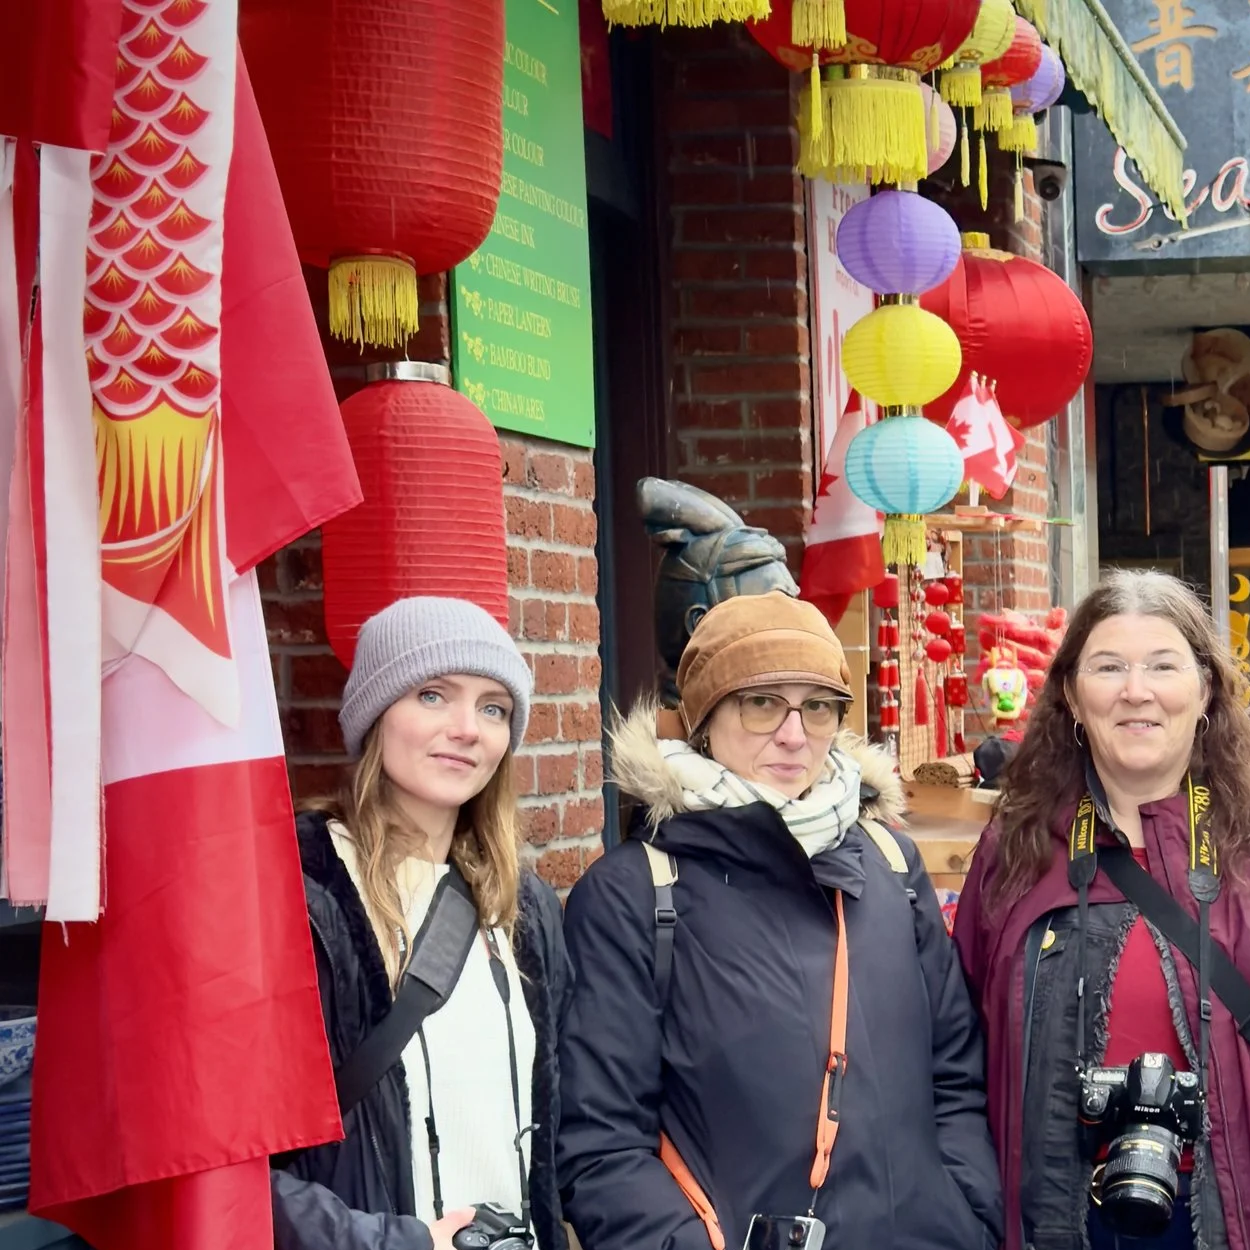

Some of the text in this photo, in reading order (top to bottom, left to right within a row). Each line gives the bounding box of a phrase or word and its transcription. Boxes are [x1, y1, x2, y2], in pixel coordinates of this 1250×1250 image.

[512, 133, 545, 167] COLOUR
[519, 178, 556, 217] PAINTING
[520, 222, 536, 249] INK
[486, 252, 580, 309] CHINESE WRITING BRUSH
[487, 297, 514, 327] PAPER
[490, 343, 551, 381] BAMBOO BLIND
[491, 388, 545, 421] CHINAWARES
[1077, 818, 1089, 850] Nikon
[1134, 1105, 1160, 1113] Nikon
